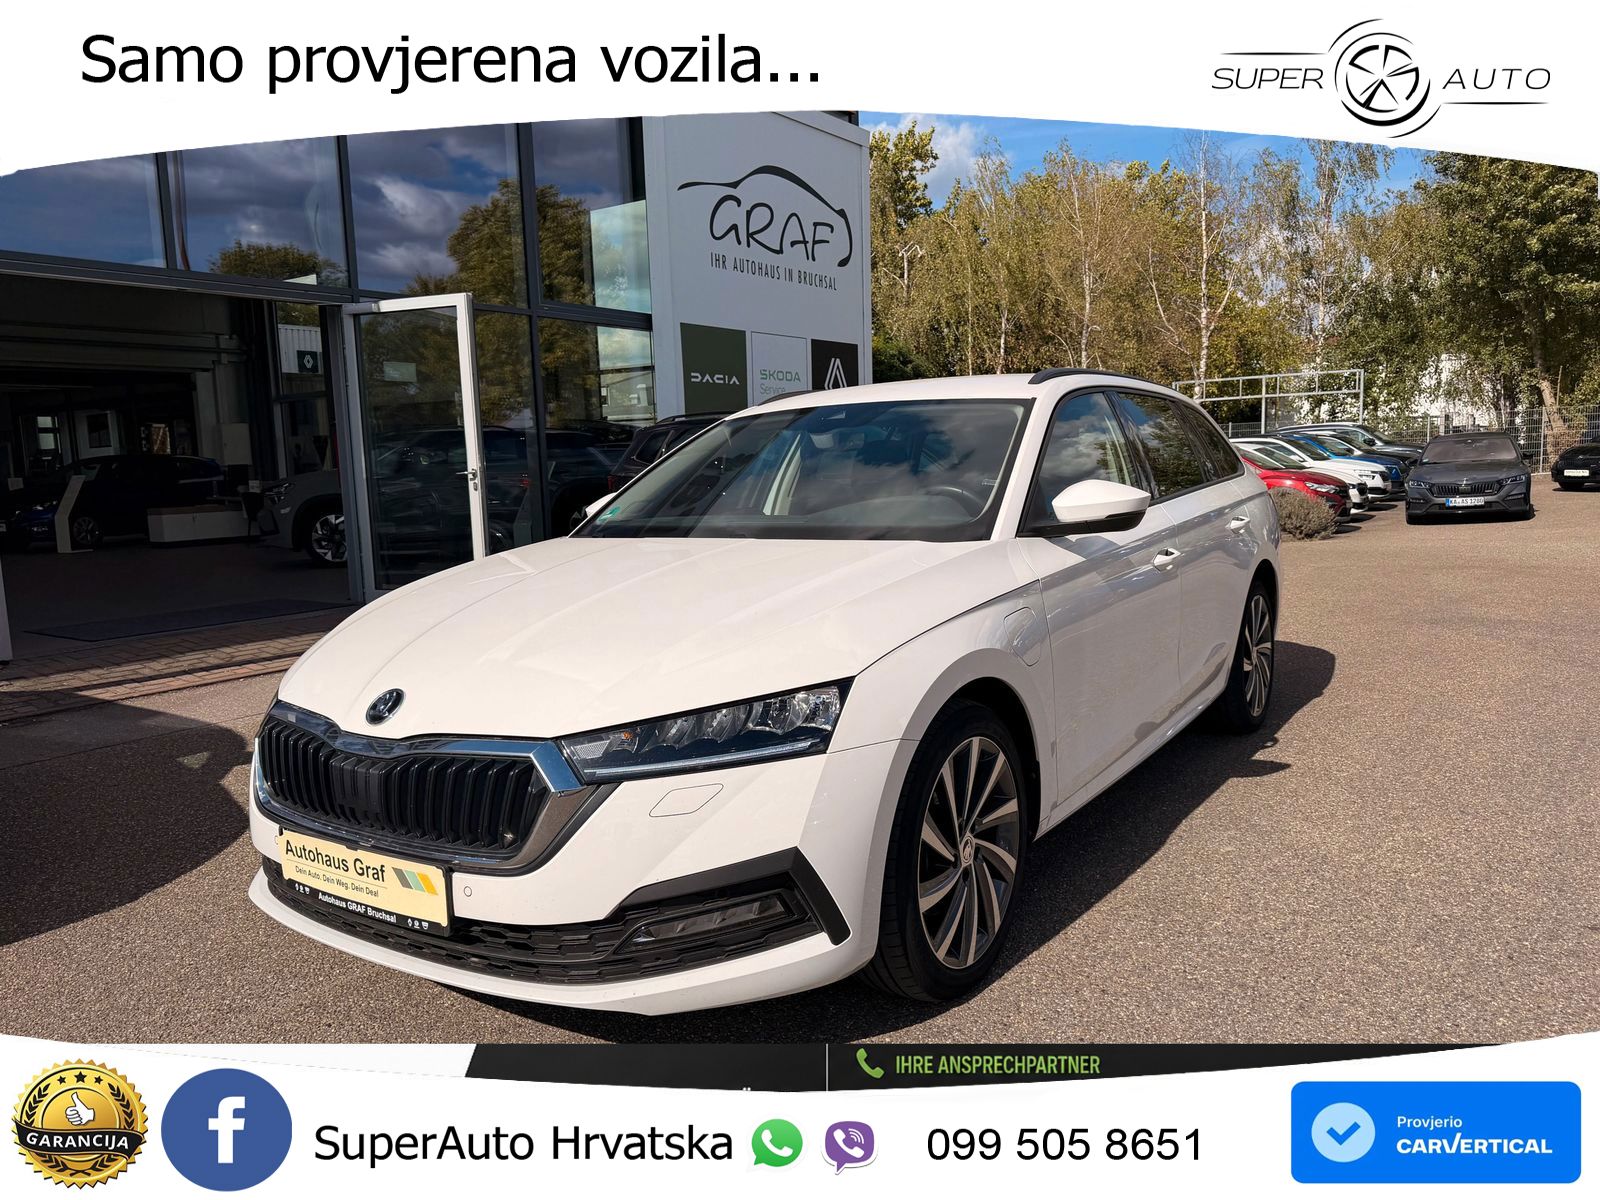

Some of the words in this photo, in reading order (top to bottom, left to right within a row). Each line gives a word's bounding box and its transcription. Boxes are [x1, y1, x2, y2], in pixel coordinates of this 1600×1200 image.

[709, 194, 835, 262] GRAF
[710, 251, 728, 271] IHR
[732, 256, 781, 281] AUTOHAUS
[784, 268, 794, 283] IN
[797, 270, 838, 292] BRUCHSAL
[690, 372, 740, 385] DACIA
[285, 839, 349, 873] Autohaus
[353, 857, 386, 883] Graf
[295, 865, 307, 873] Dein
[307, 869, 322, 880] Auto.
[322, 874, 335, 884] Dein
[336, 878, 351, 891] Weg.
[351, 883, 365, 894] Dein
[365, 886, 379, 898] Deal
[318, 892, 346, 908] Autohaus
[347, 901, 366, 914] GRAF
[367, 906, 396, 923] Bruchsal
